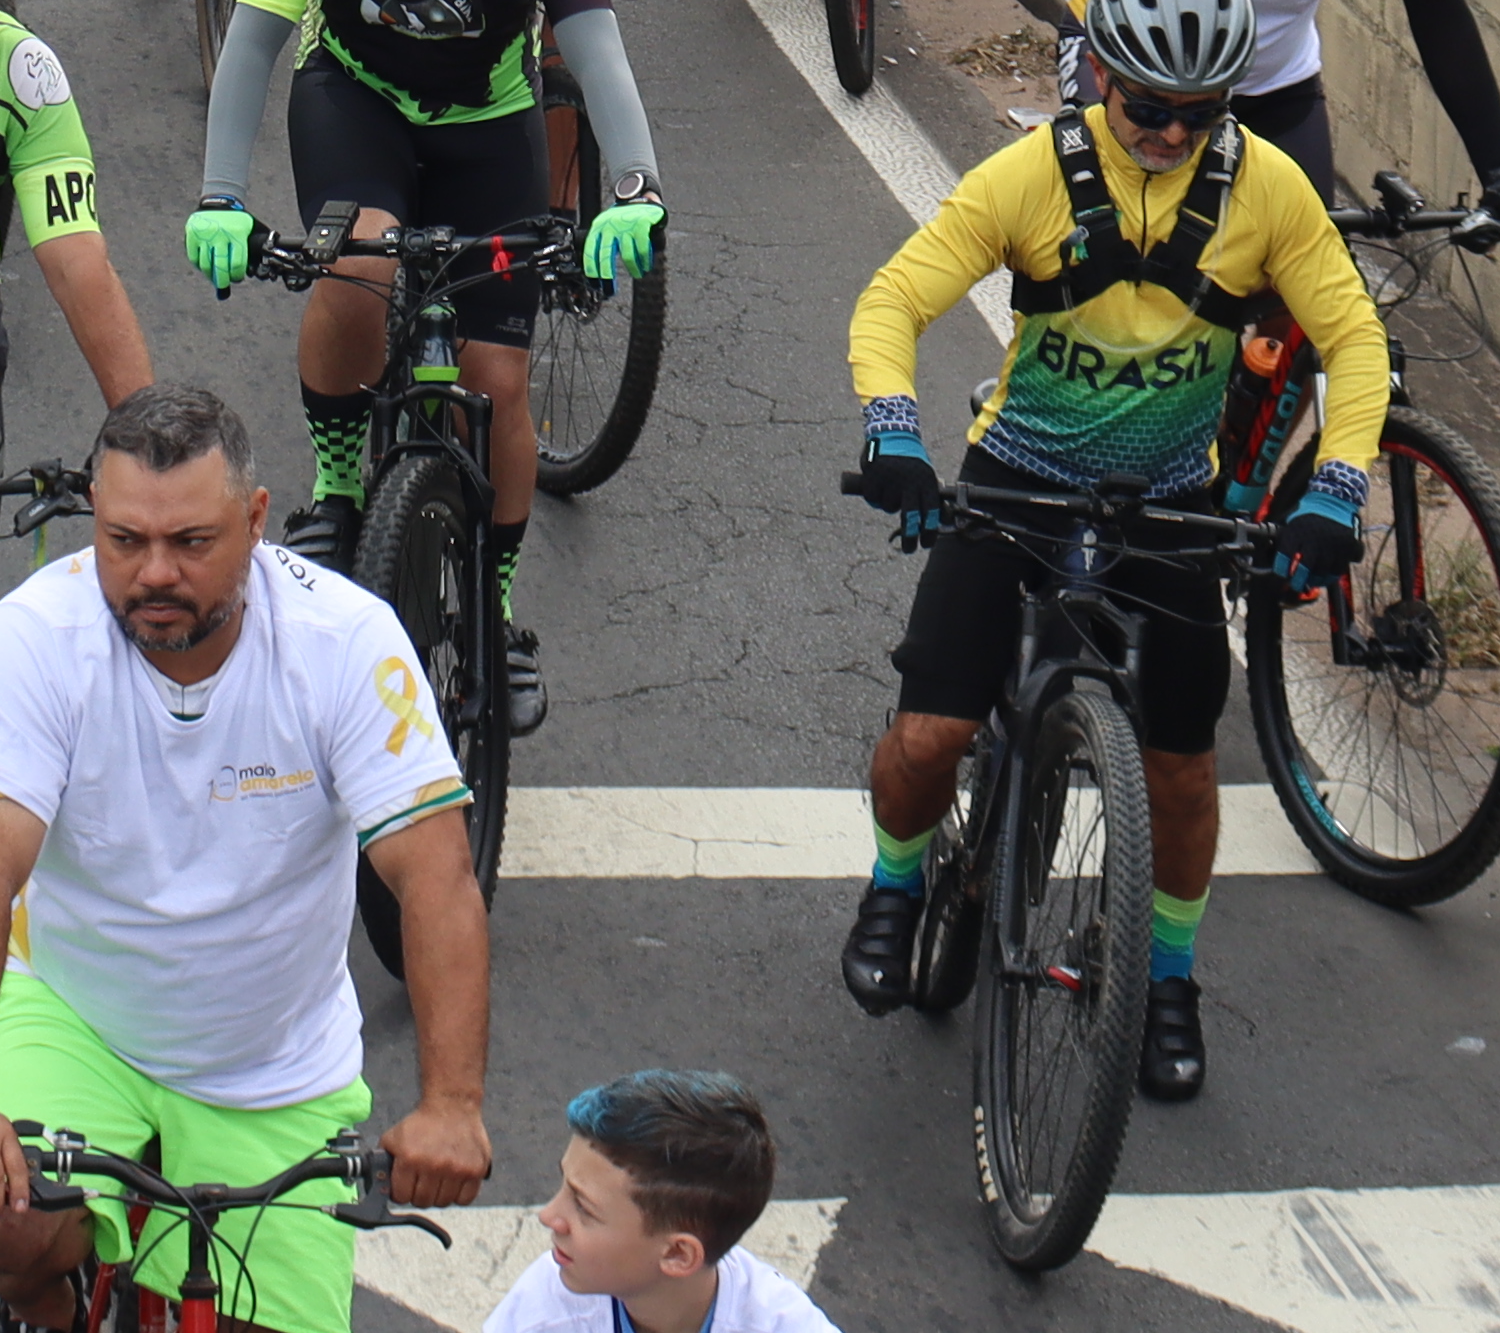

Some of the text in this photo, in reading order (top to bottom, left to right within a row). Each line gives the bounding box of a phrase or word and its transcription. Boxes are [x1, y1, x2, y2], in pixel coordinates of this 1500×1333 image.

[1038, 326, 1216, 391] BRASIL
[275, 547, 316, 592] TOD
[239, 763, 275, 780] maio
[240, 770, 315, 792] amarelo
